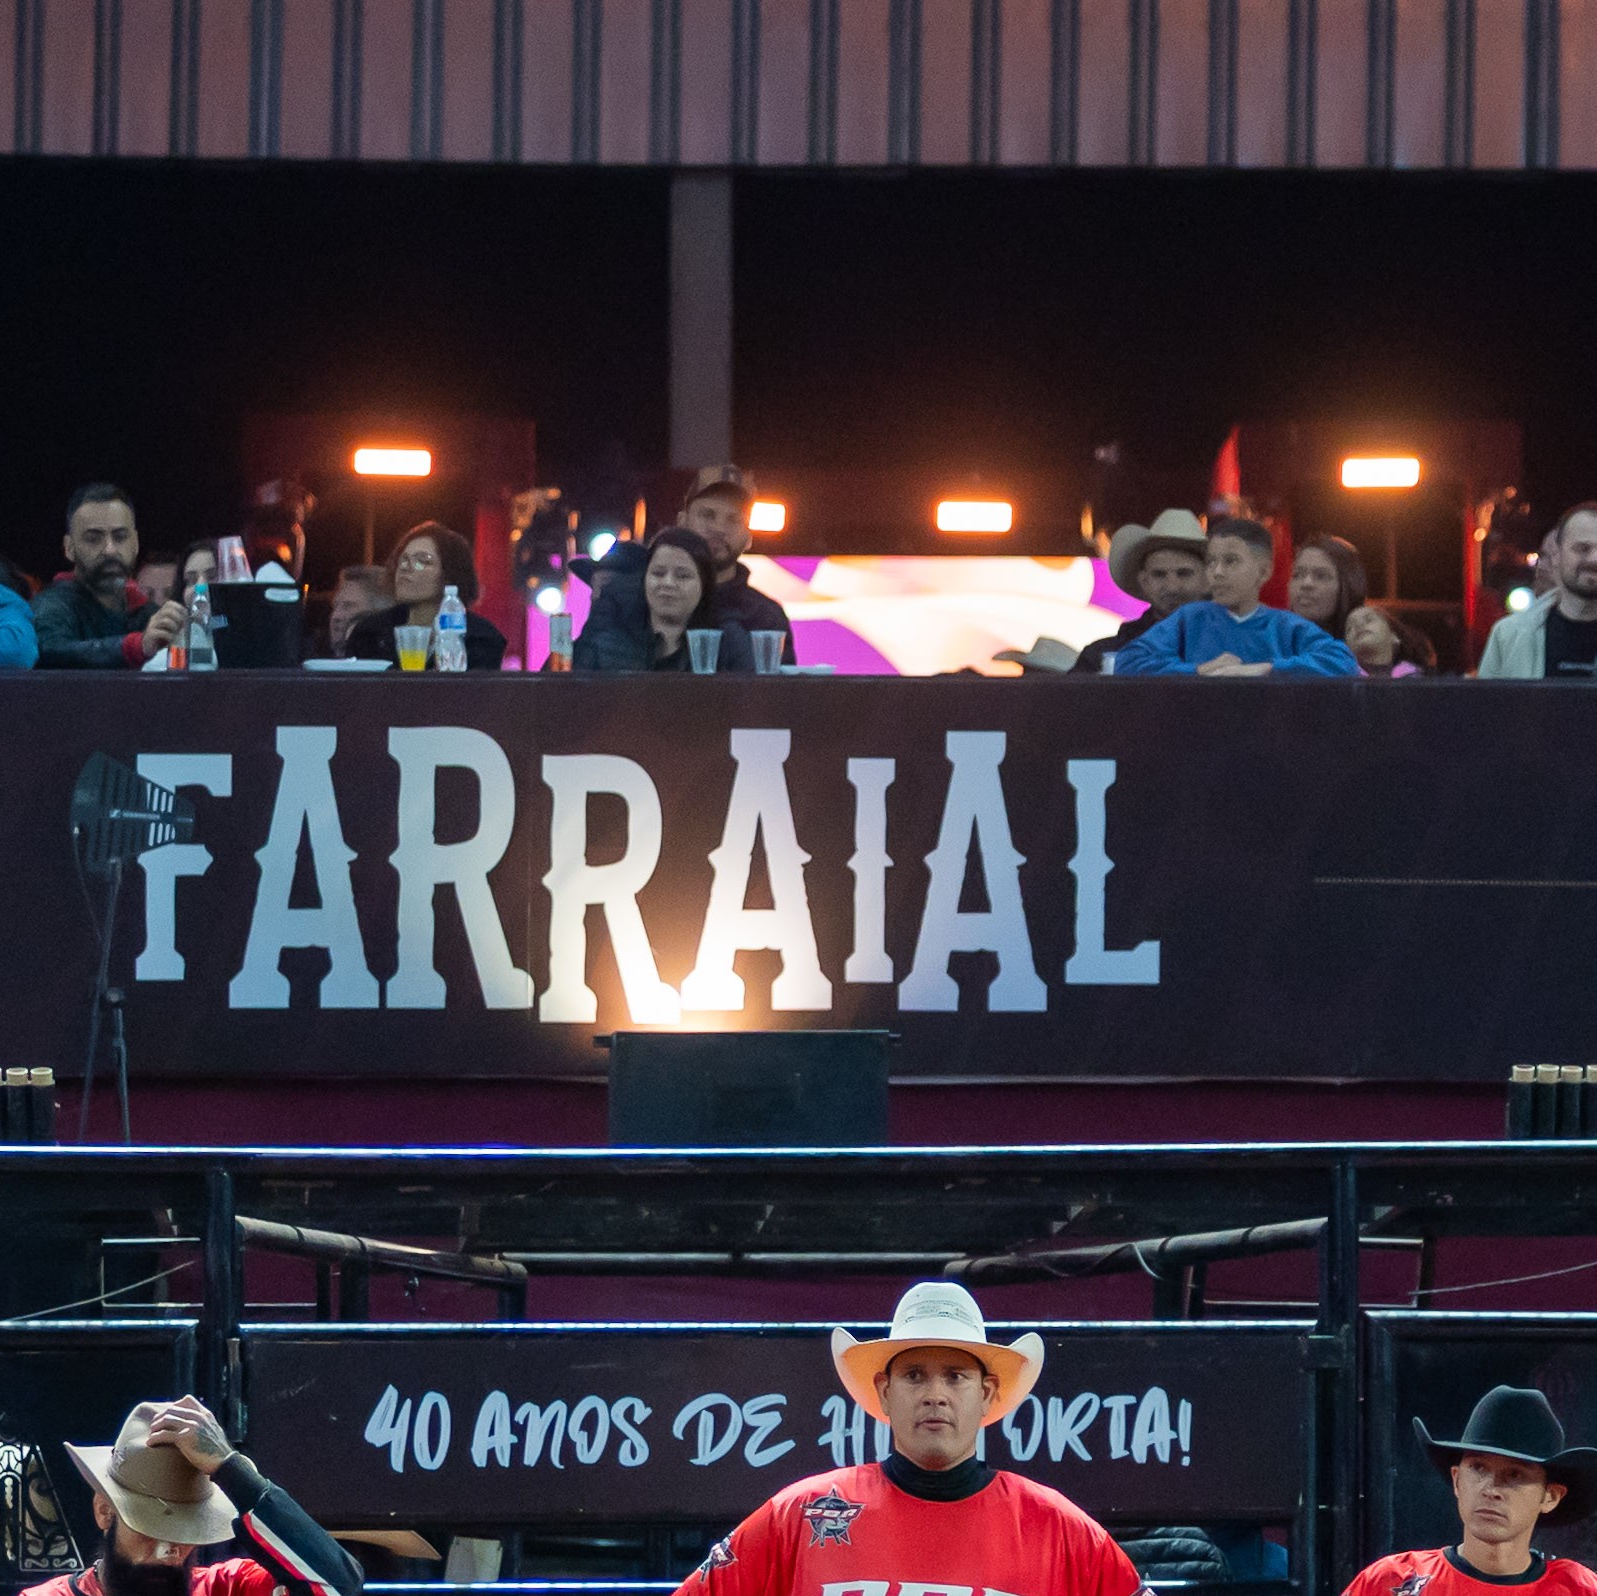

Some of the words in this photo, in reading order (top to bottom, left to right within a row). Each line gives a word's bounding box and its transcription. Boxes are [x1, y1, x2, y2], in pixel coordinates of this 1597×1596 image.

[135, 725, 1161, 1024] FARRAIAL
[364, 1384, 451, 1472] 40
[470, 1390, 651, 1469] ANOS
[673, 1392, 798, 1468] DE
[804, 1507, 860, 1519] PBR
